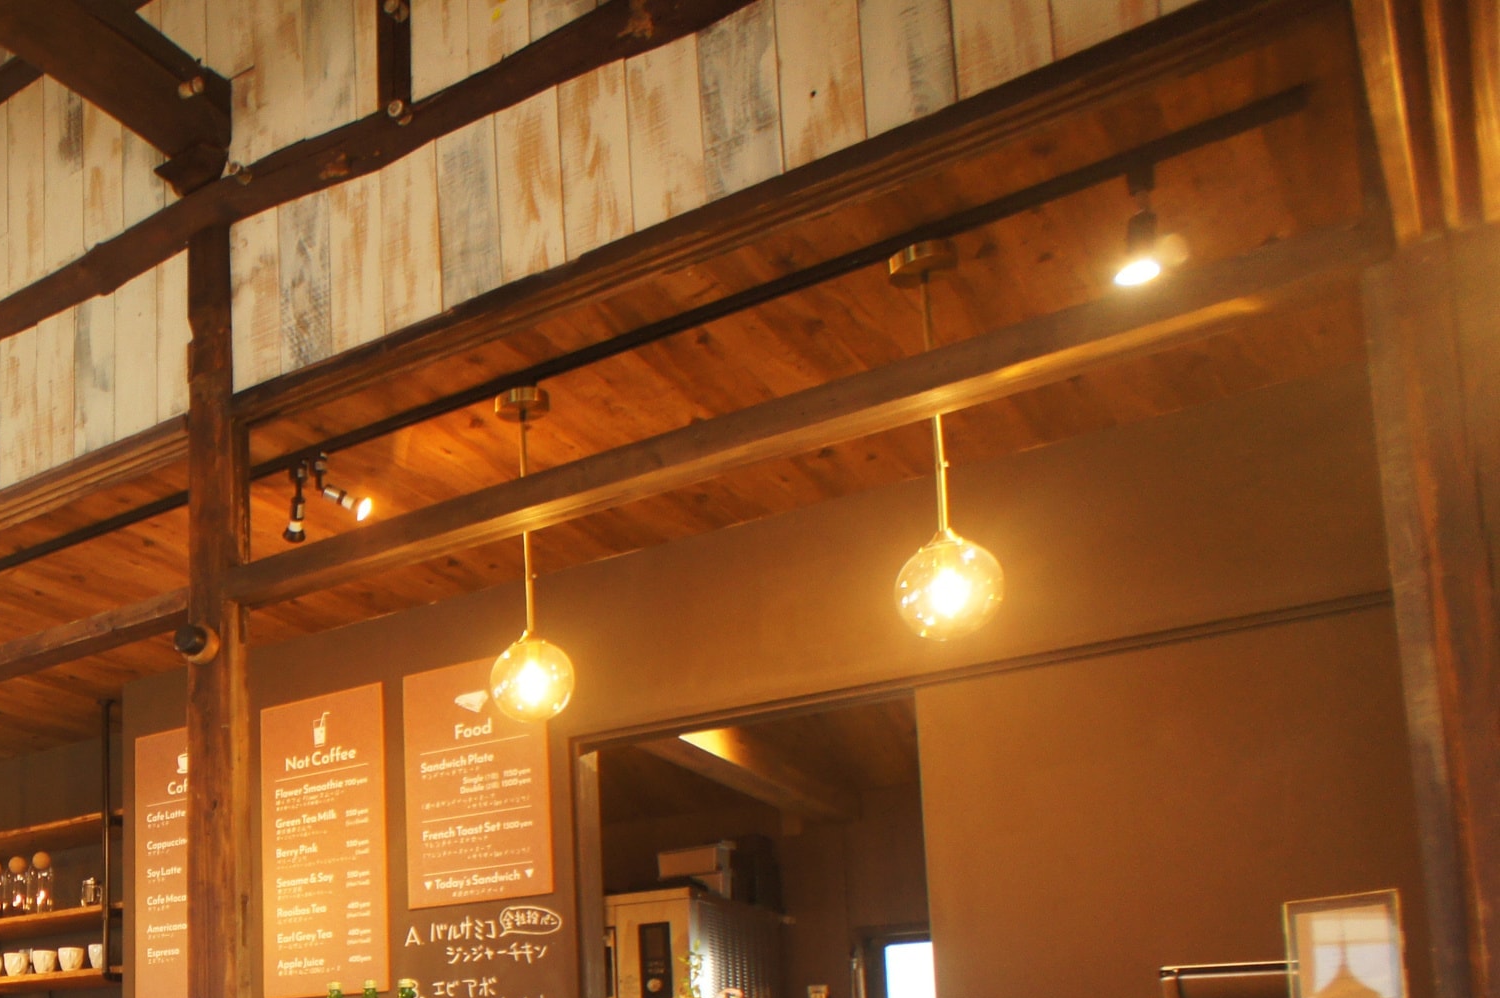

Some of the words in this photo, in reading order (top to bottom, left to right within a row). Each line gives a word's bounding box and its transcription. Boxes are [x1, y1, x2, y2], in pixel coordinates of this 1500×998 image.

[454, 717, 492, 740] Food
[285, 755, 310, 772] Not
[311, 746, 357, 767] Coffee
[420, 756, 466, 774] Sandwich
[467, 753, 494, 765] Plate
[276, 788, 302, 800] Flower
[303, 779, 343, 795] Smoothie
[147, 811, 165, 823] Cafe
[165, 809, 186, 820] Latte
[276, 818, 300, 830] Green
[301, 814, 317, 825] Tea
[318, 809, 336, 821] Milk
[422, 828, 455, 842] French
[456, 824, 483, 837] Toast
[484, 821, 501, 834] Set
[276, 846, 298, 860] Berry
[299, 842, 318, 855] Pink
[147, 868, 160, 880] Soy
[161, 866, 182, 877] Latte
[276, 876, 308, 889] Sesame
[309, 872, 316, 883] &
[317, 871, 333, 884] Soy
[471, 869, 521, 887] Sandwich
[147, 895, 165, 907] Cafe
[277, 904, 310, 918] Rooibos
[311, 902, 327, 913] Tea
[277, 931, 294, 944] Earl
[295, 930, 316, 943] Grey
[317, 928, 332, 939] Tea
[430, 915, 497, 942] バルサミコ
[147, 947, 180, 959] Espresso
[446, 942, 548, 964] ジンジャーチキン
[277, 956, 303, 970] Apple
[304, 957, 324, 969] Juice
